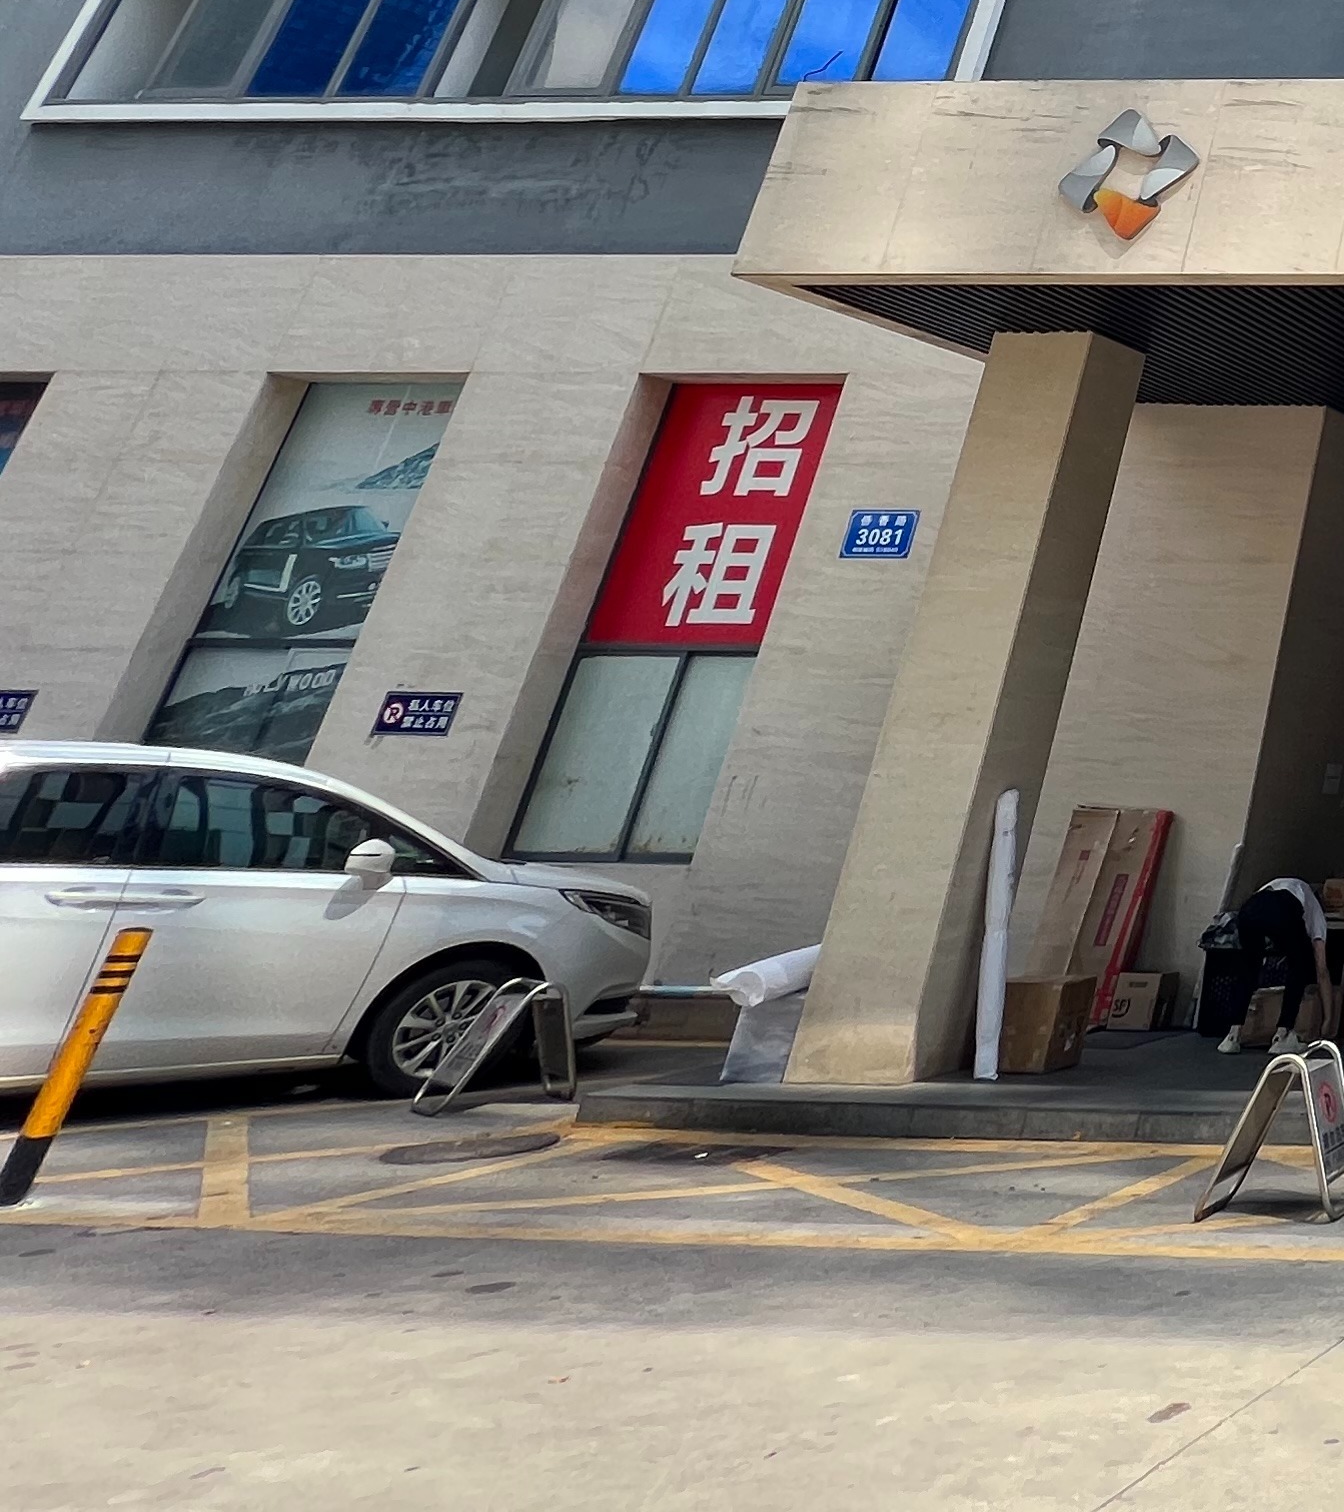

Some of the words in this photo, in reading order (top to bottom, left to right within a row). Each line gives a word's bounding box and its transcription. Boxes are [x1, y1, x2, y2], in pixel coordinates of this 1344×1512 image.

[661, 396, 820, 627] 招租
[855, 528, 904, 545] 3081
[1113, 998, 1127, 1011] SF
